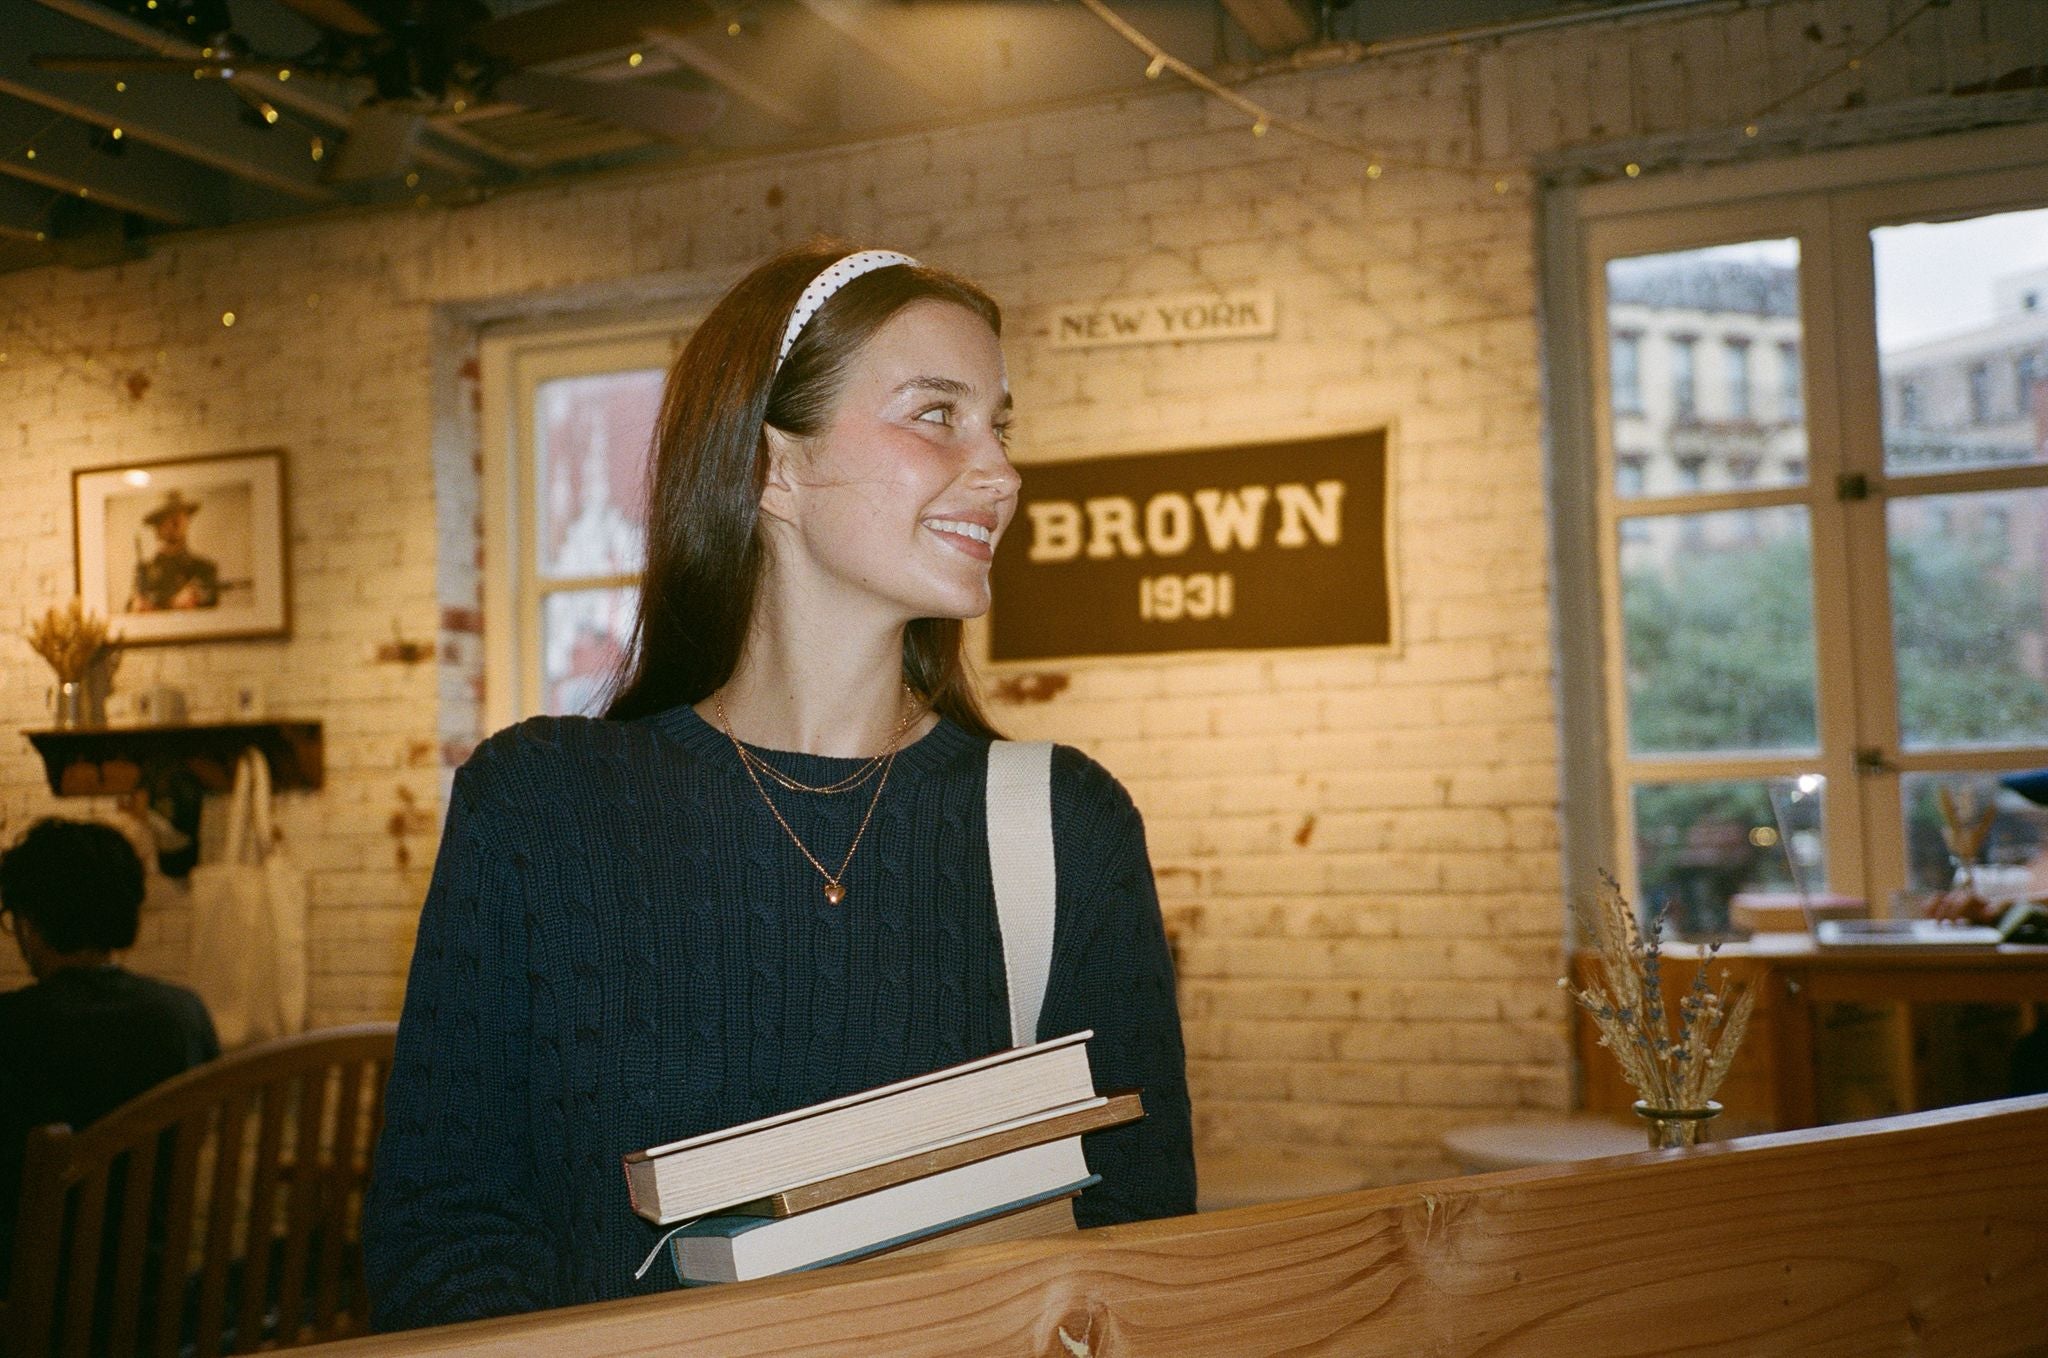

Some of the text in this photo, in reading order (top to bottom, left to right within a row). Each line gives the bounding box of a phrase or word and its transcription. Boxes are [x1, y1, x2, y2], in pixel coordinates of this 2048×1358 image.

[1060, 301, 1261, 340] NEW YORK
[1028, 479, 1345, 562] BROWN
[1139, 572, 1234, 621] 1931
